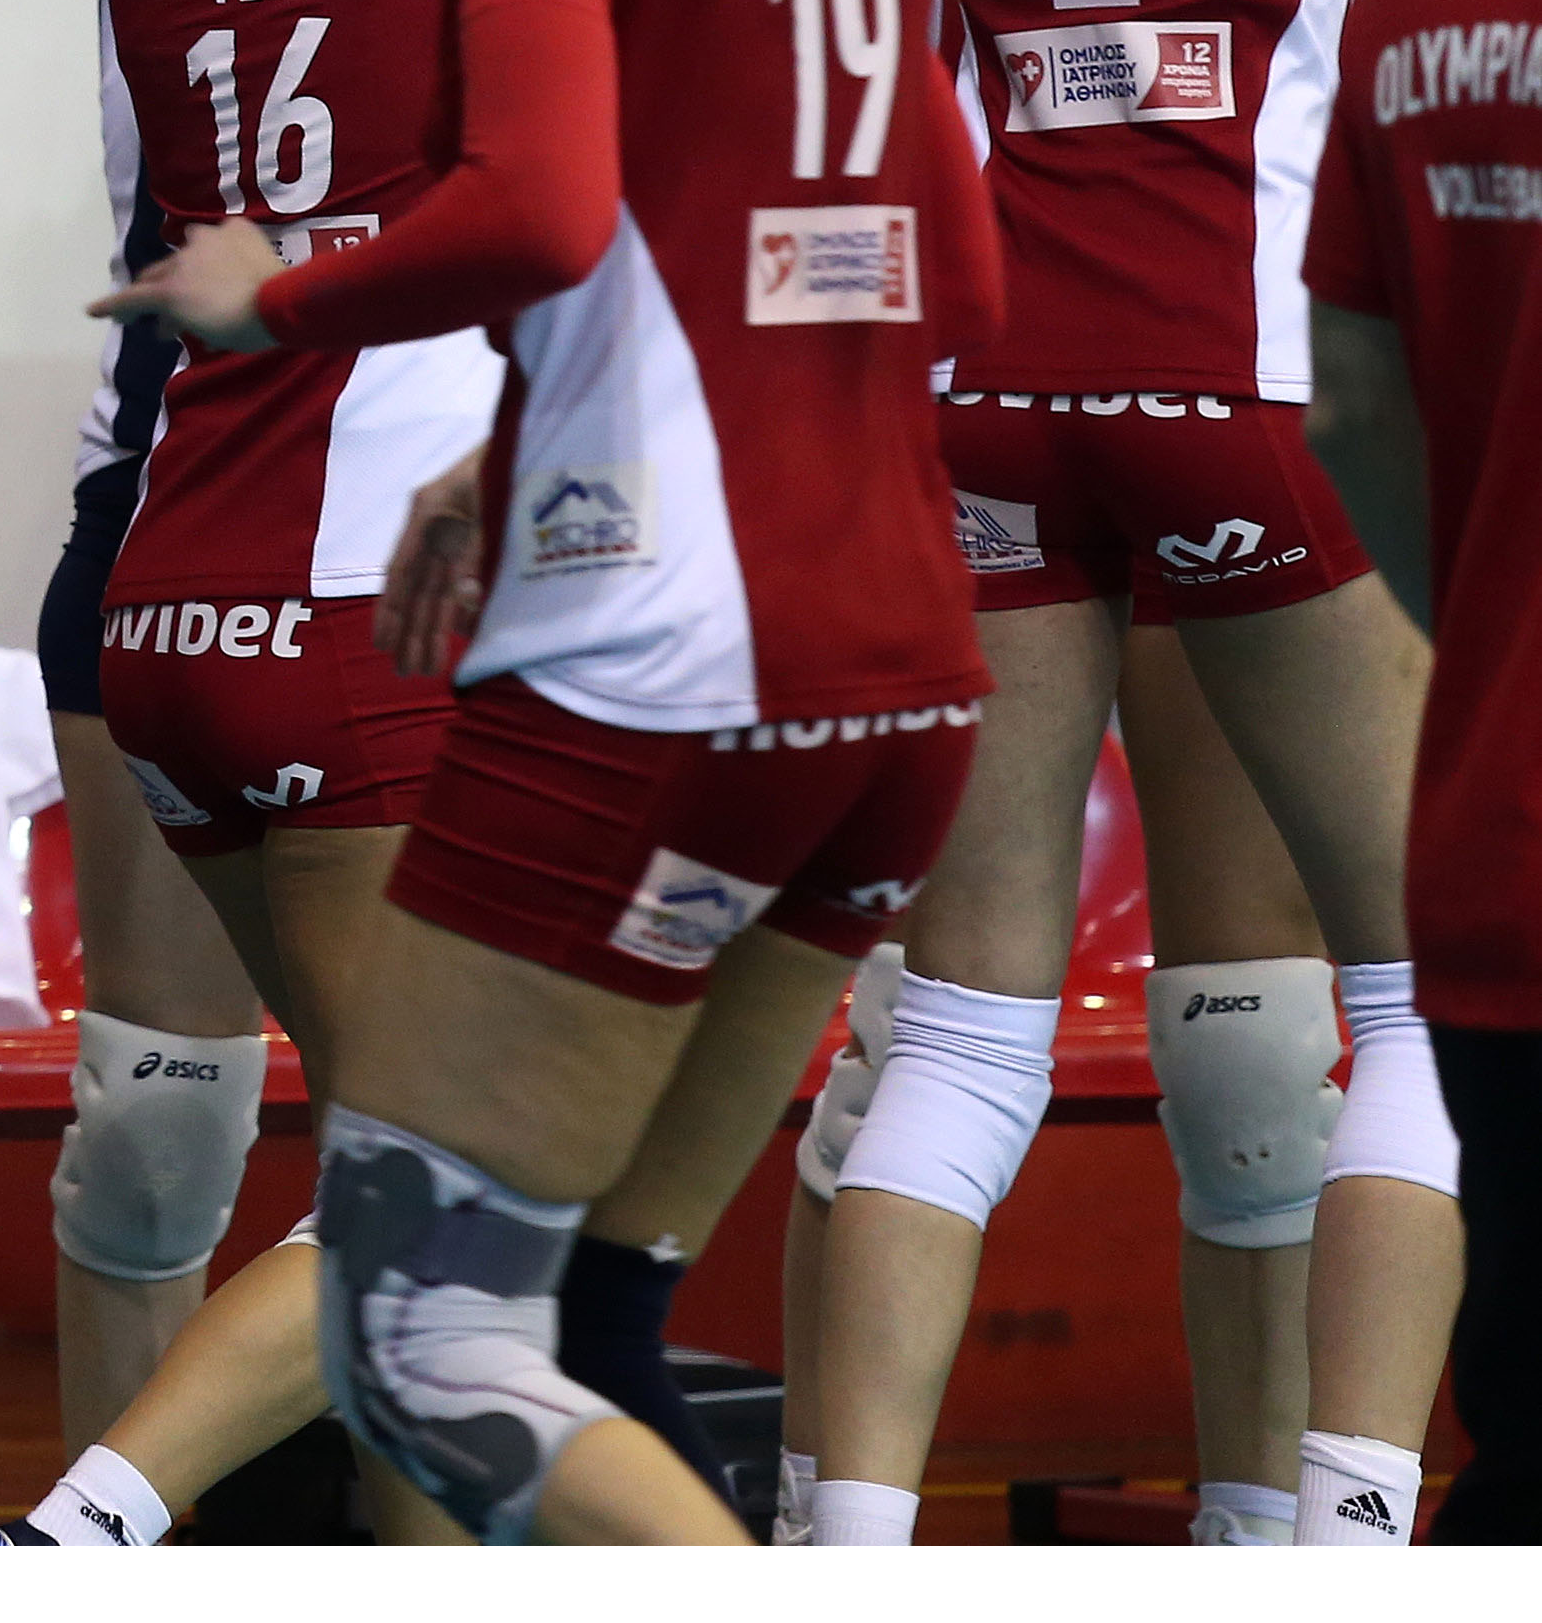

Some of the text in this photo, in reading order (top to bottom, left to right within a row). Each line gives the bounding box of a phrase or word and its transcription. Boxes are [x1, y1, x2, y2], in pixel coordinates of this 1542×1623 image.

[1181, 41, 1212, 64] 12
[185, 17, 333, 215] 16
[162, 1058, 220, 1081] asics
[1336, 1504, 1398, 1535] adidas
